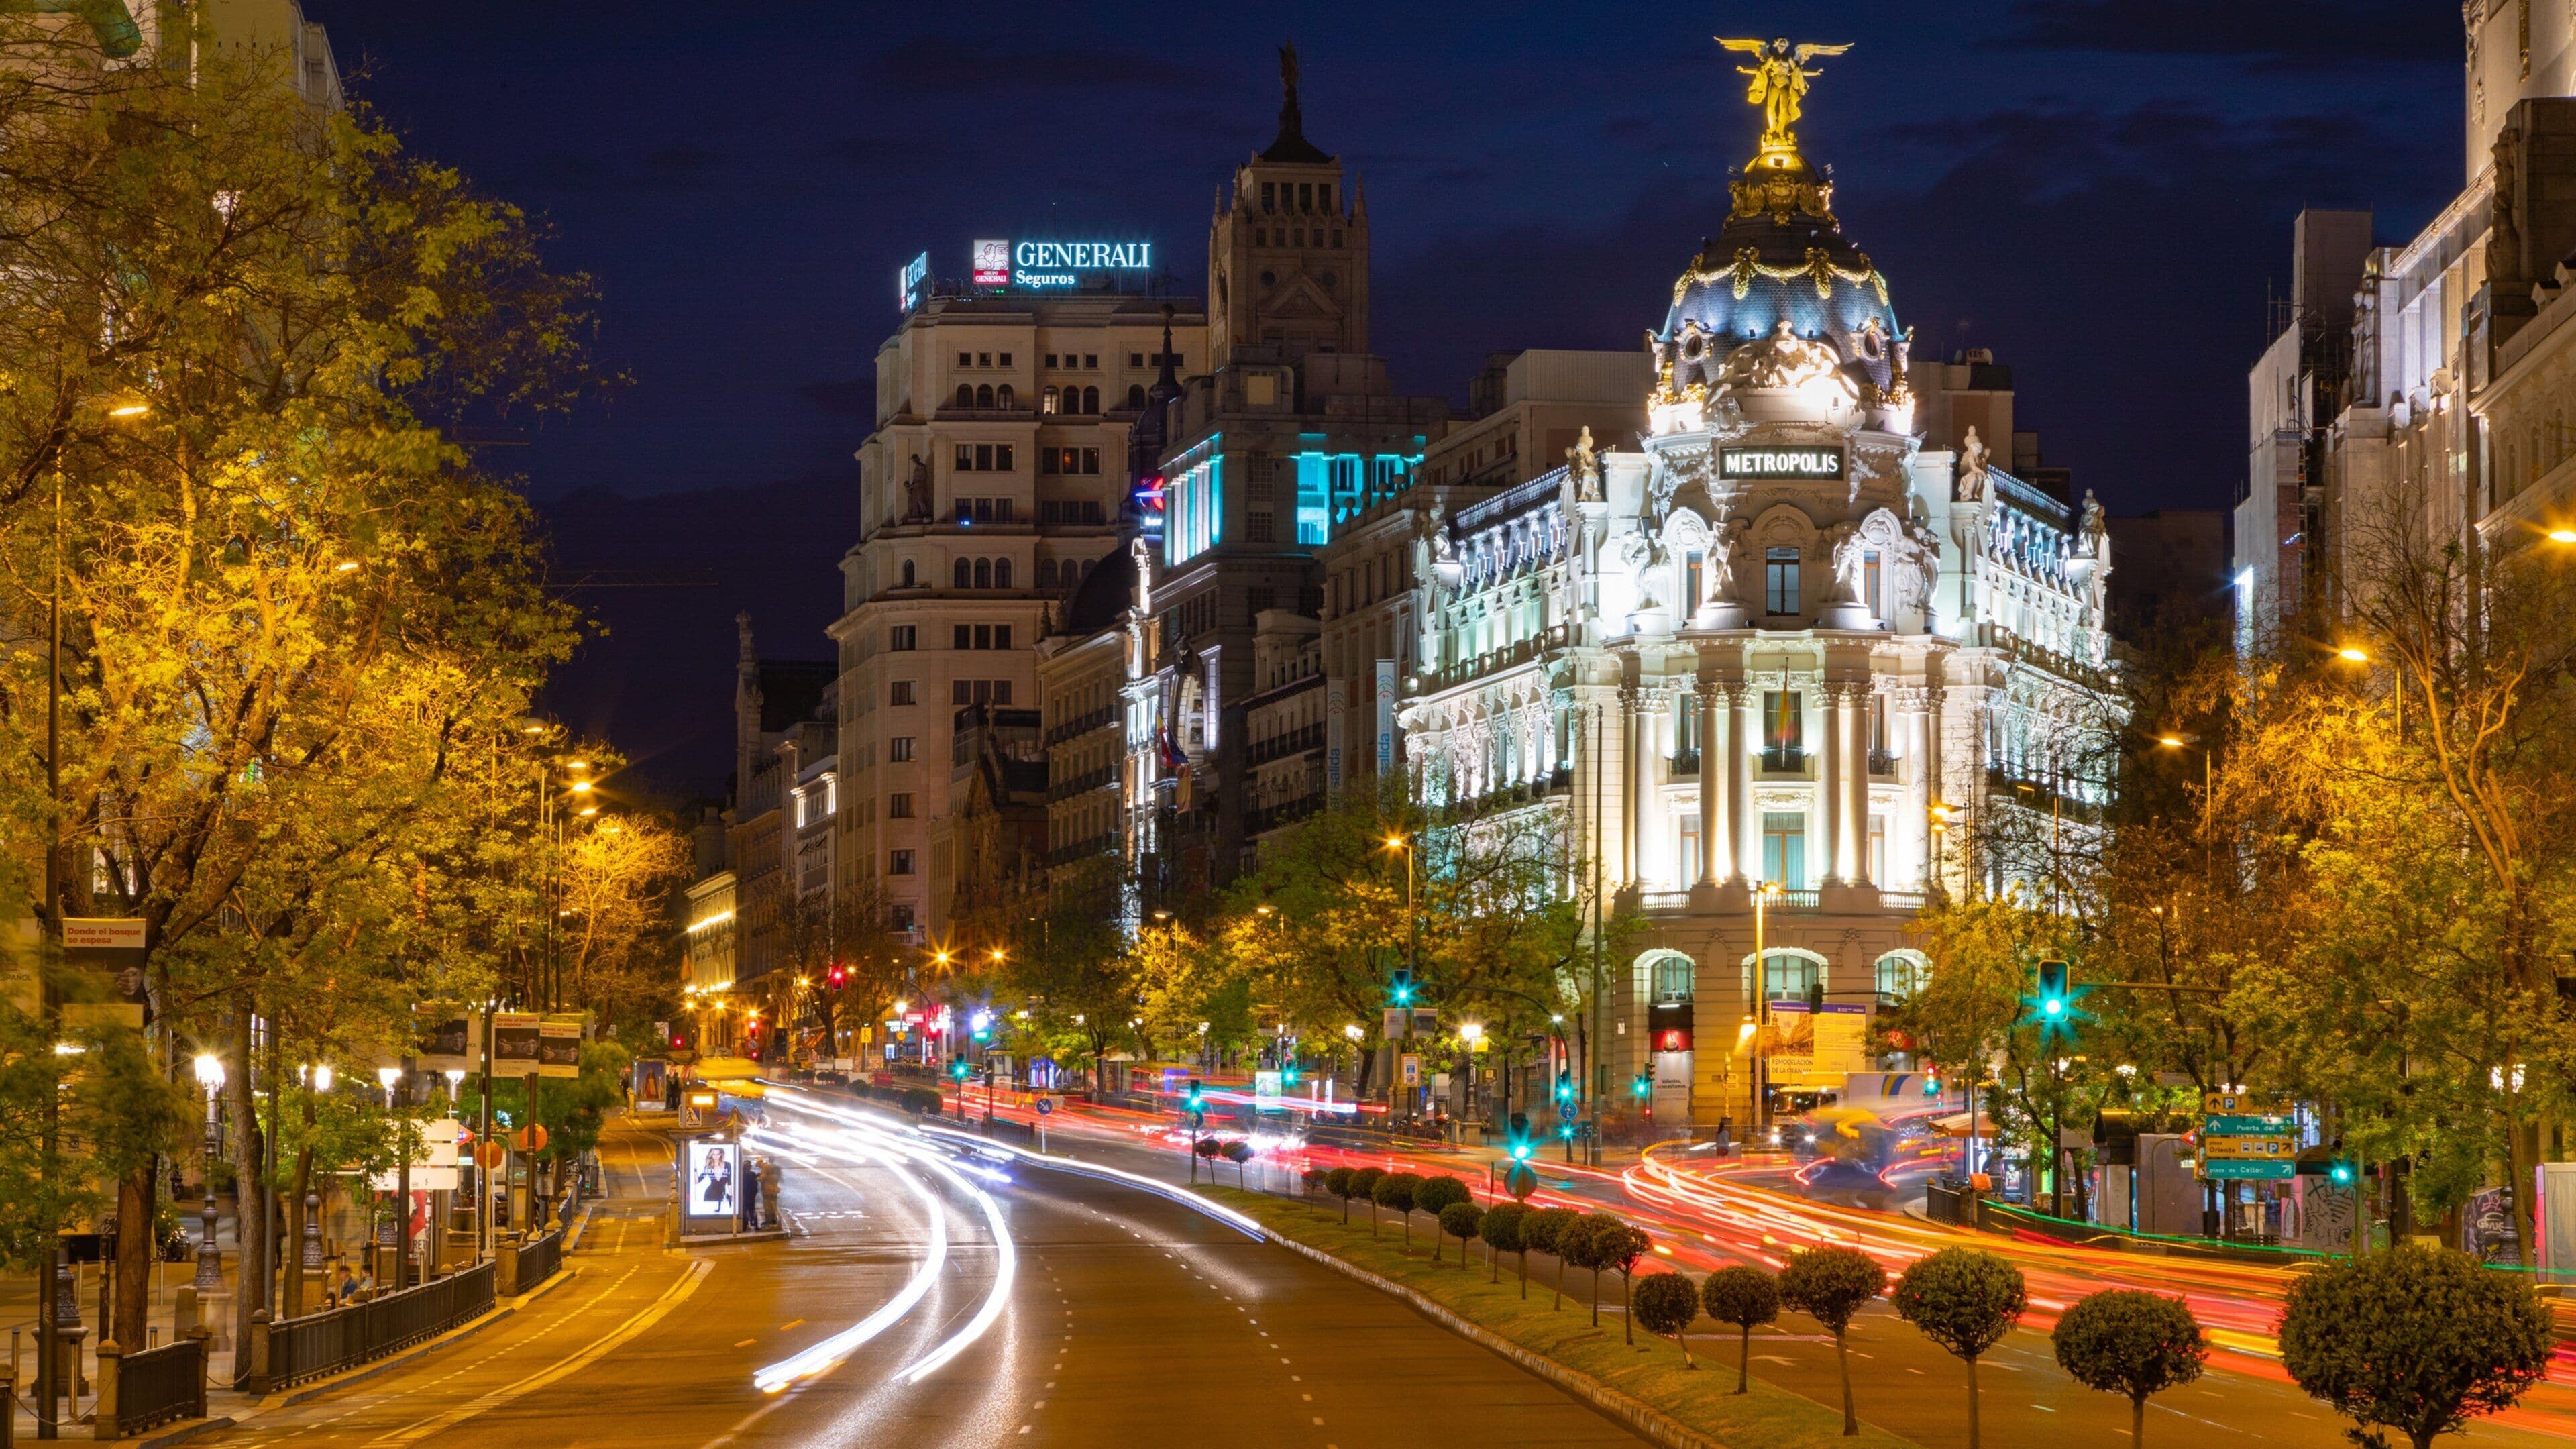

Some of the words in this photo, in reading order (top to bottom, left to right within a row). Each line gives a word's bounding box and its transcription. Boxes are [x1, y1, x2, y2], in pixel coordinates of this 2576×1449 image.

[1016, 242, 1150, 267] GENERALI
[1016, 270, 1074, 288] Seguros
[1725, 453, 1838, 472] METROPOLIS
[1378, 733, 1391, 774] salida
[1328, 748, 1340, 788] salida
[109, 928, 141, 936] bosque
[0, 973, 32, 981] SPAÑOL
